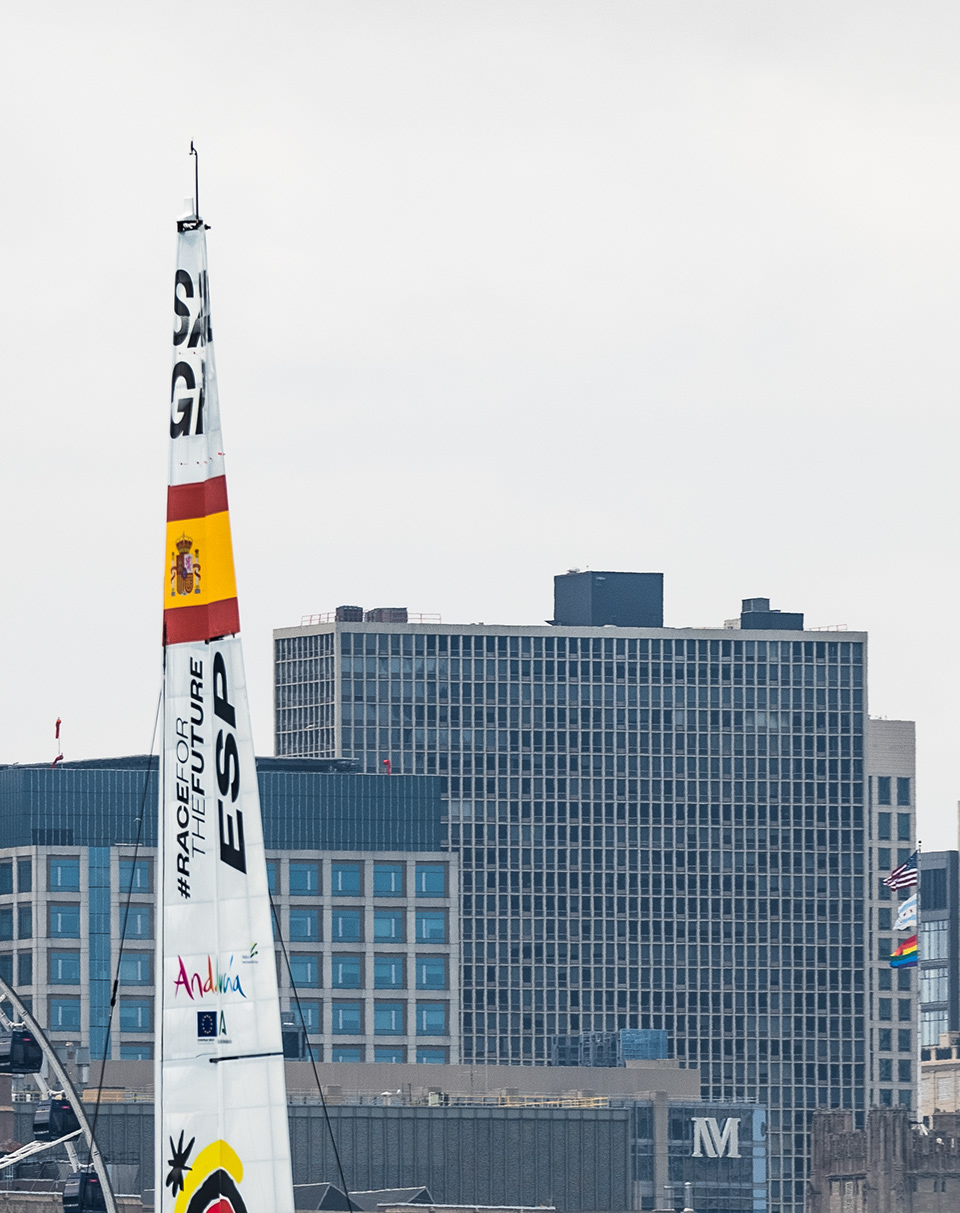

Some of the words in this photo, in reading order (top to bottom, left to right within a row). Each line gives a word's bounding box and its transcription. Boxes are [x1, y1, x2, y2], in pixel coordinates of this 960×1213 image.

[175, 717, 191, 901] #RACEFOR
[213, 651, 247, 875] ESP
[691, 1117, 742, 1158] M
